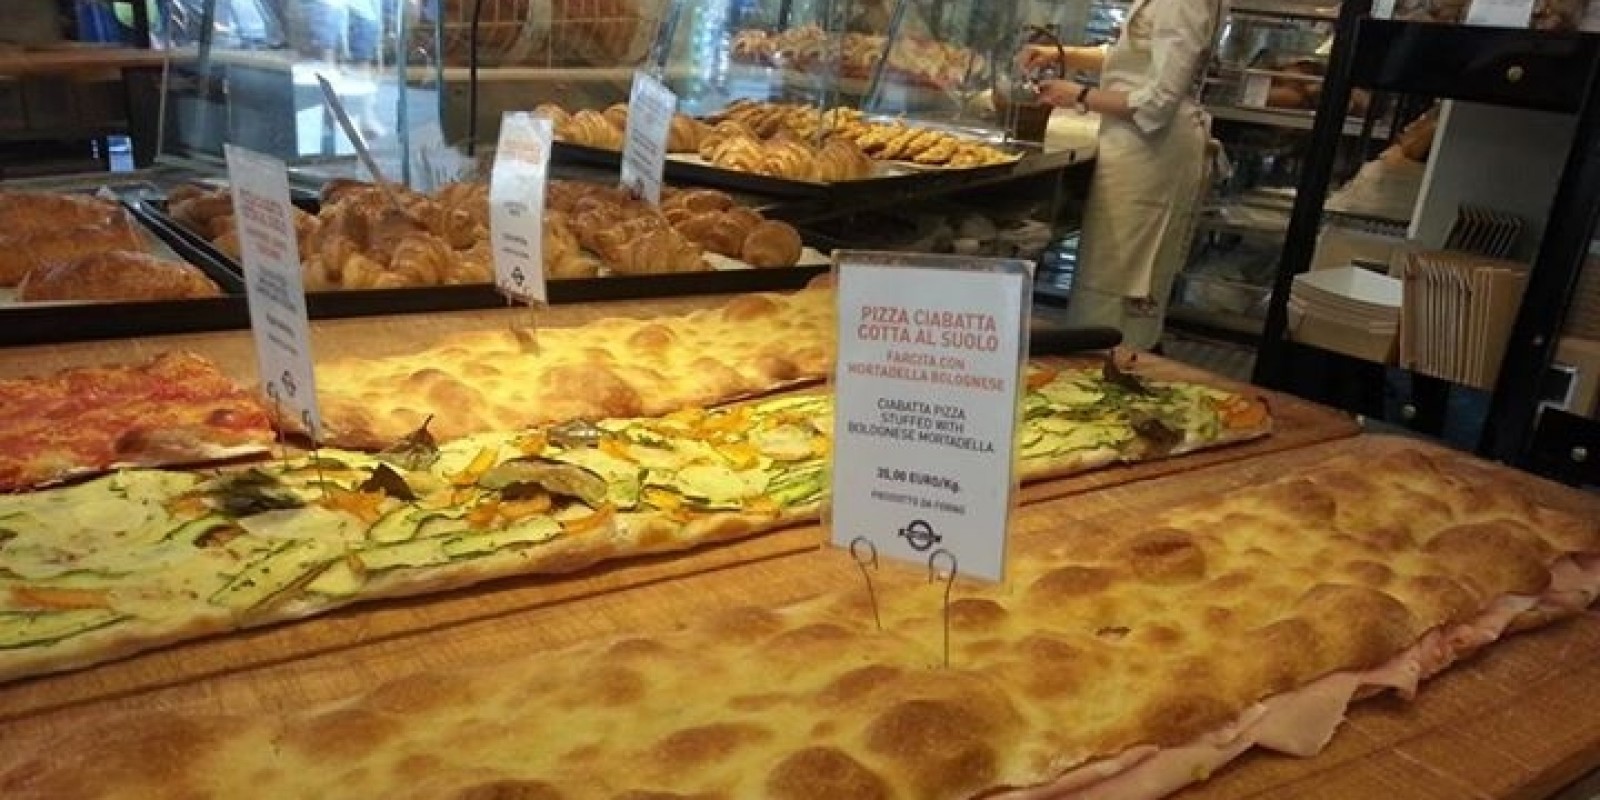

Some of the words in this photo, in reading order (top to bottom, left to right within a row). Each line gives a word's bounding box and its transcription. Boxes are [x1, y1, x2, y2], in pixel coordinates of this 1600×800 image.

[861, 306, 909, 323] PIZZA
[914, 309, 996, 332] CIABATTA
[857, 323, 911, 342] COTTA
[915, 331, 936, 345] AL
[941, 331, 999, 352] SUOLO
[886, 350, 936, 366] FARCITA
[939, 357, 965, 369] CON
[847, 362, 927, 381] MORTADELLA
[931, 370, 1005, 390] BOLOGNESE
[878, 397, 931, 414] CIABATTA
[934, 403, 966, 419] PIZZA
[881, 413, 932, 429] STUFFED
[935, 420, 963, 433] WITH
[849, 421, 915, 441] BOLOGNESE
[918, 431, 994, 453] MORTADELLA
